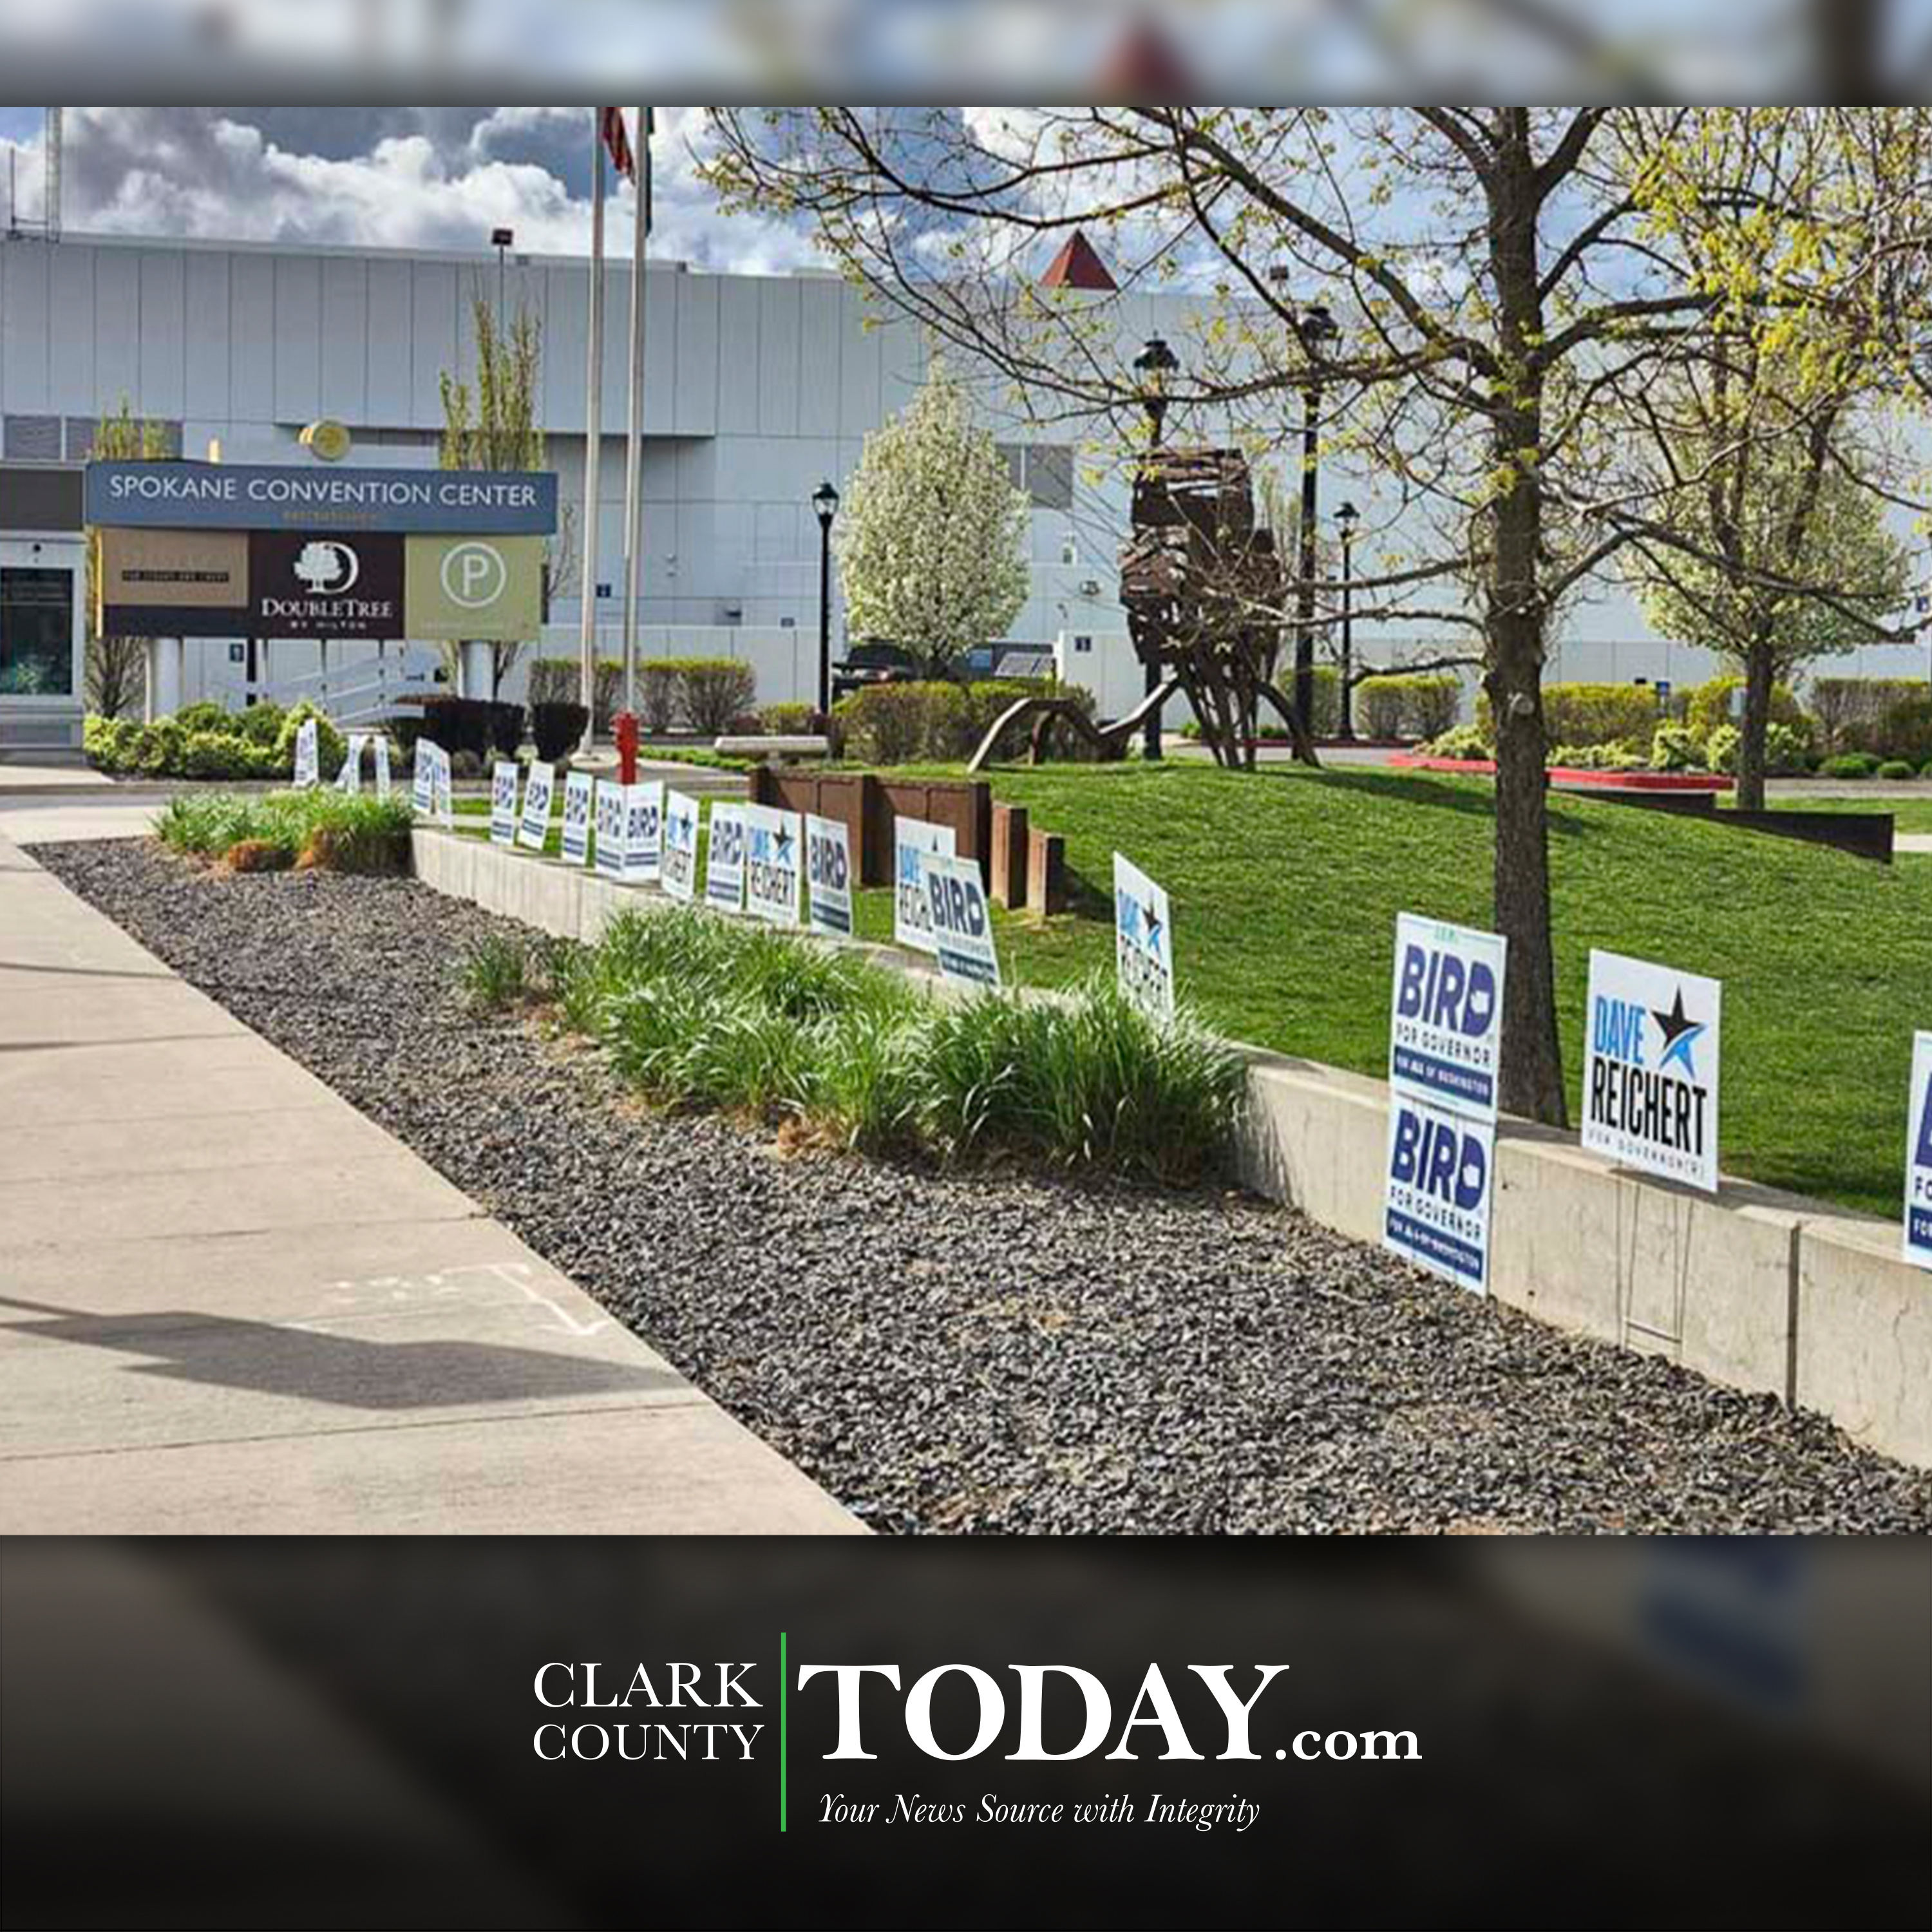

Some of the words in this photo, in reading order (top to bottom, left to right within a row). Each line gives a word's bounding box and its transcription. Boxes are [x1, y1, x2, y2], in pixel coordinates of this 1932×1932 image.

[110, 475, 236, 500] SPOKANE
[248, 477, 431, 505] CONVENTION
[439, 482, 536, 507] CENTER
[627, 806, 658, 838] BIRD
[710, 819, 742, 866] BIRD
[810, 835, 848, 891] BIRD
[929, 871, 985, 936] BIRD
[1397, 943, 1496, 1039] BIRD
[1421, 1030, 1491, 1068] GOVERNOR
[1593, 995, 1646, 1065] DAVE
[1590, 1056, 1707, 1157] REICHERT
[1390, 1108, 1486, 1211] BIRD
[1416, 1198, 1481, 1242] GOVERNOR
